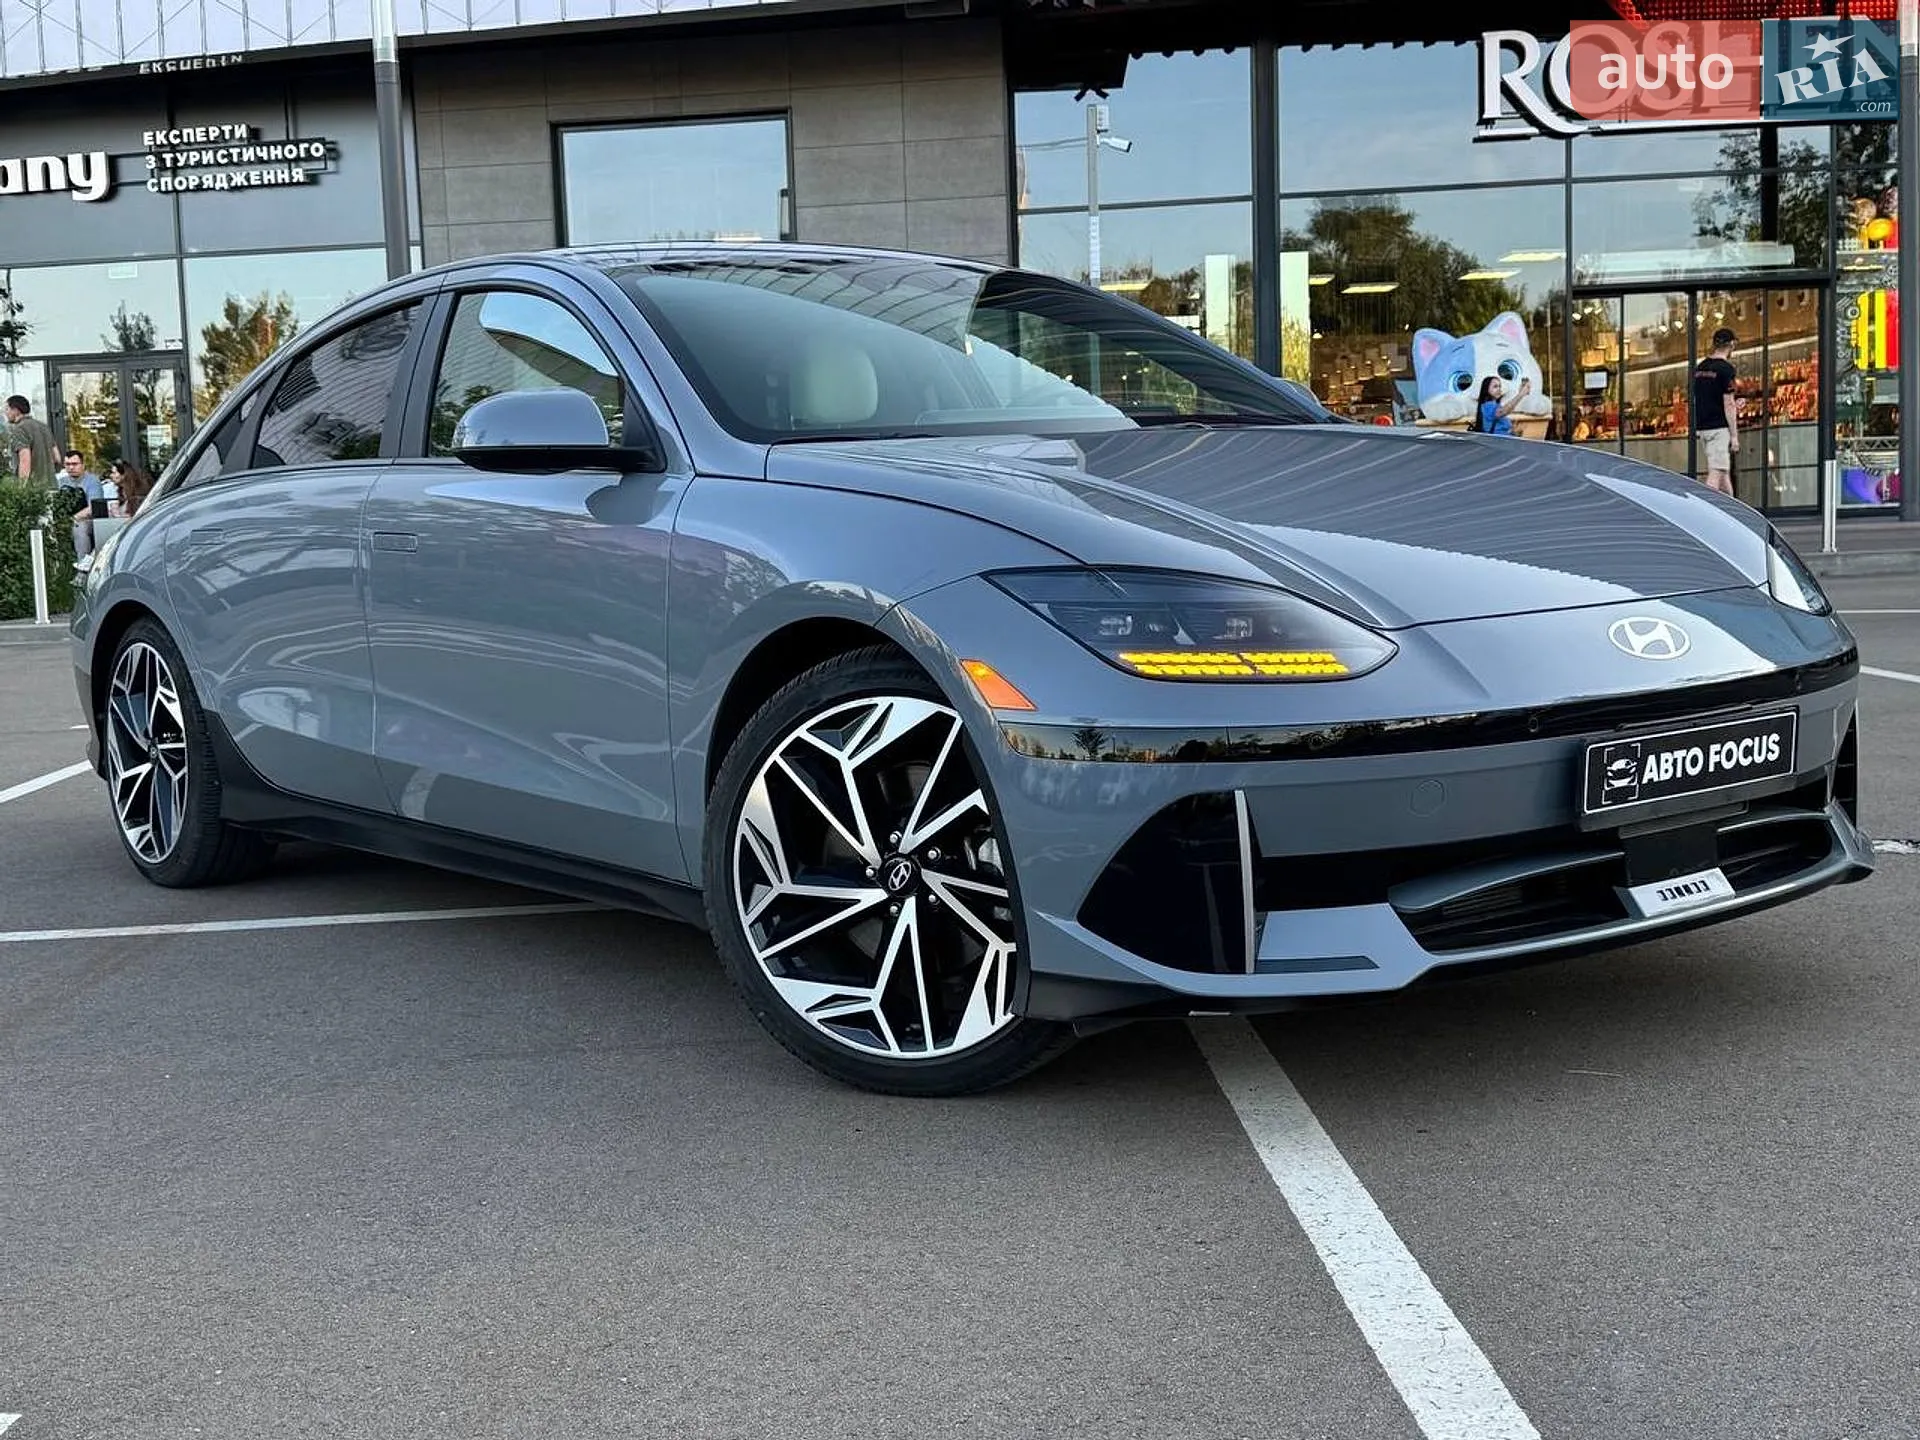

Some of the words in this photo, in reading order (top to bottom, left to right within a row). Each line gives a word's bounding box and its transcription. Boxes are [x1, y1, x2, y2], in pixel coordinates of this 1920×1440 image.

[143, 124, 248, 147] ЕКСПЕРТИ
[163, 143, 324, 169] ТУРИСТИЧНОГО
[146, 168, 304, 193] СПОРЯДЖЕННЯ
[1708, 733, 1780, 773] FOCUS
